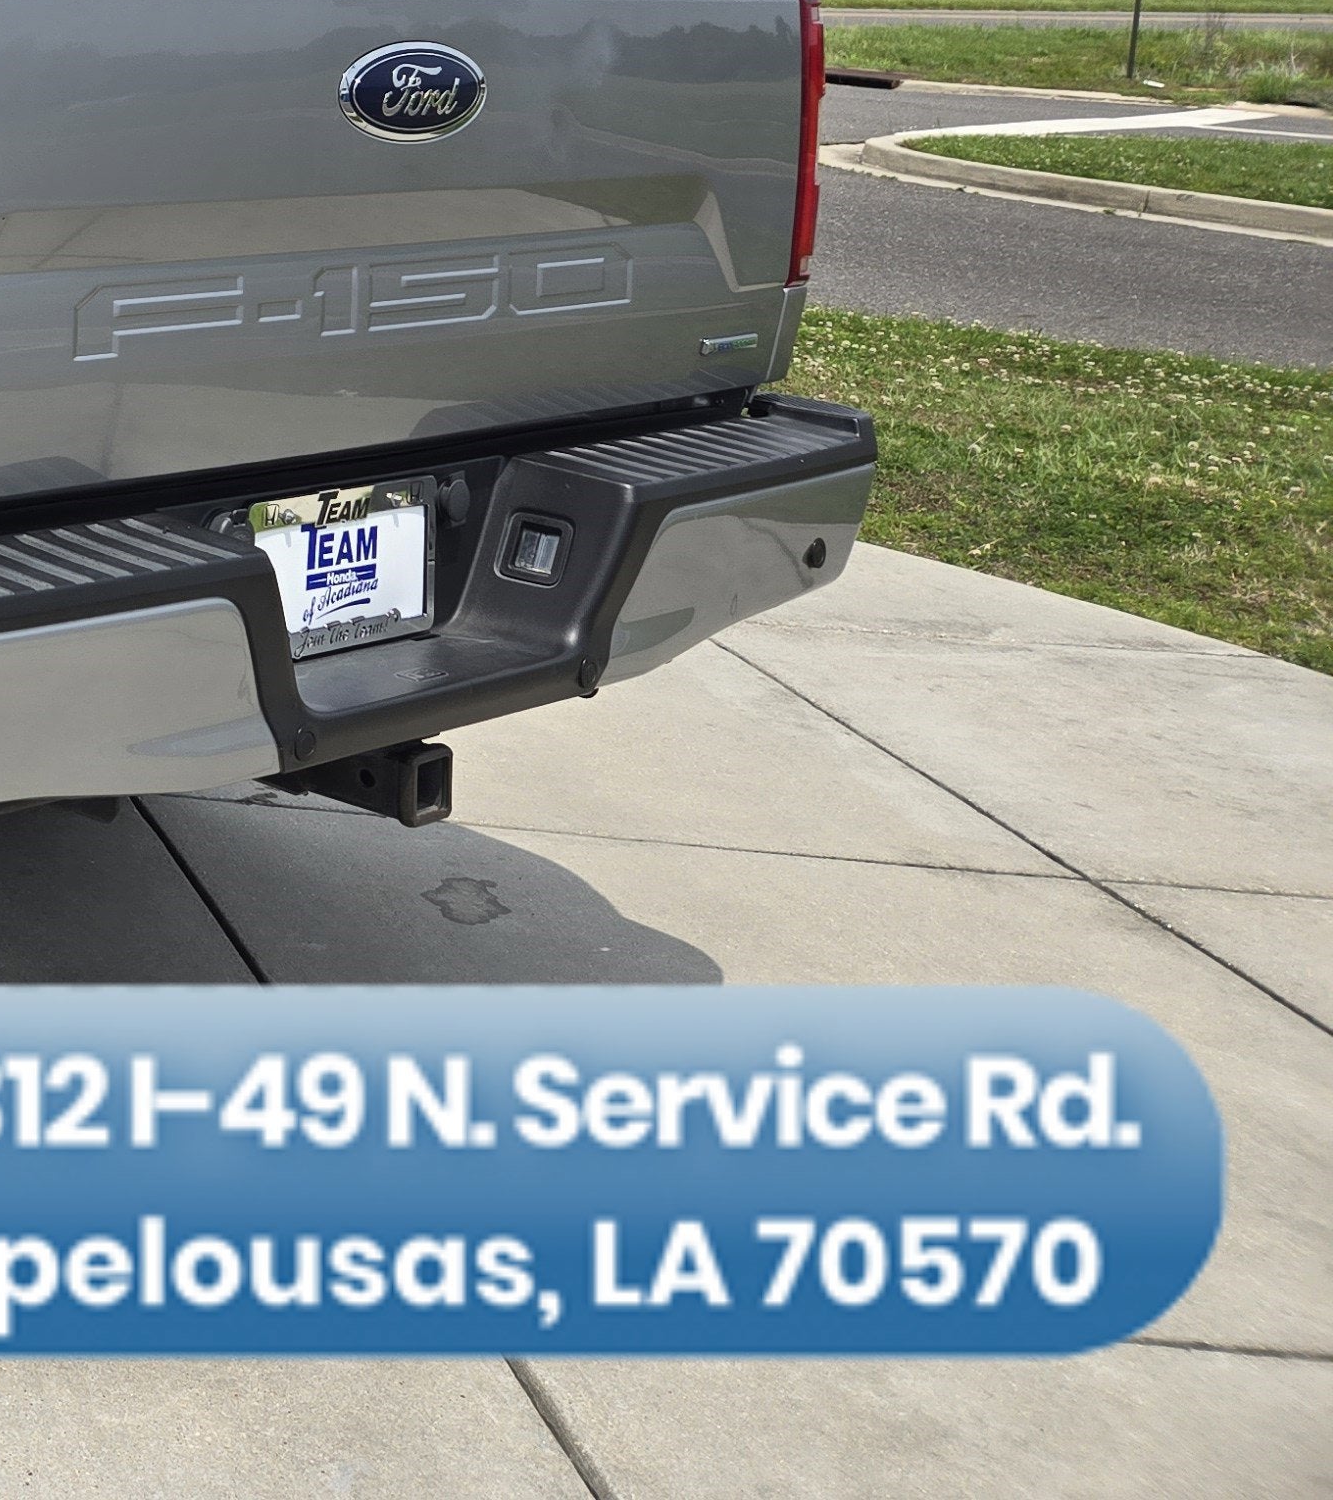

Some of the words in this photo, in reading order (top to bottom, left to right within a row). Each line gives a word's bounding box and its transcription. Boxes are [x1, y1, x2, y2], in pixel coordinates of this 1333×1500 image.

[381, 63, 461, 117] Ford
[73, 241, 632, 361] F-150
[315, 489, 370, 528] TEAM
[301, 522, 378, 571] TEAM
[302, 596, 316, 623] of
[317, 578, 379, 611] Acadiana
[326, 569, 359, 586] Honda
